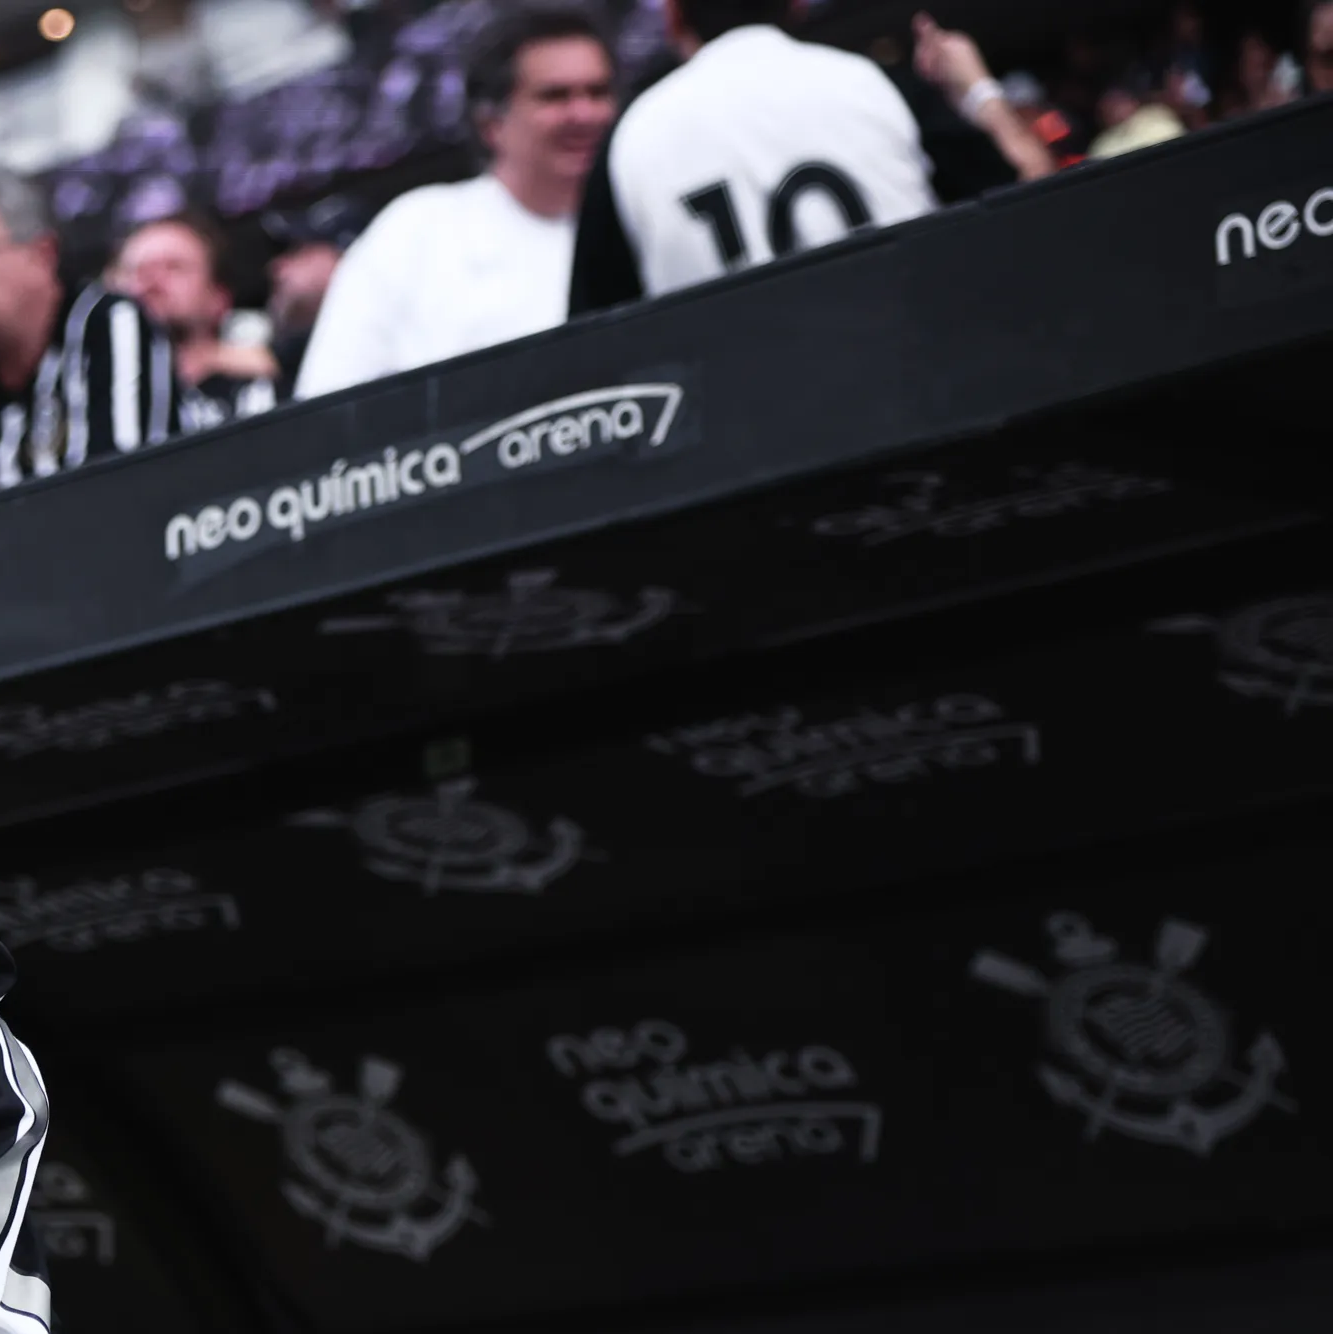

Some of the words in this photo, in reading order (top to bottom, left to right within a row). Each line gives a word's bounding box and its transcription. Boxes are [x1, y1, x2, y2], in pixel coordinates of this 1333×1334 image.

[679, 162, 871, 268] 10
[1215, 186, 1333, 265] neo
[165, 504, 262, 560] neo
[266, 445, 461, 541] química
[498, 400, 643, 467] arena
